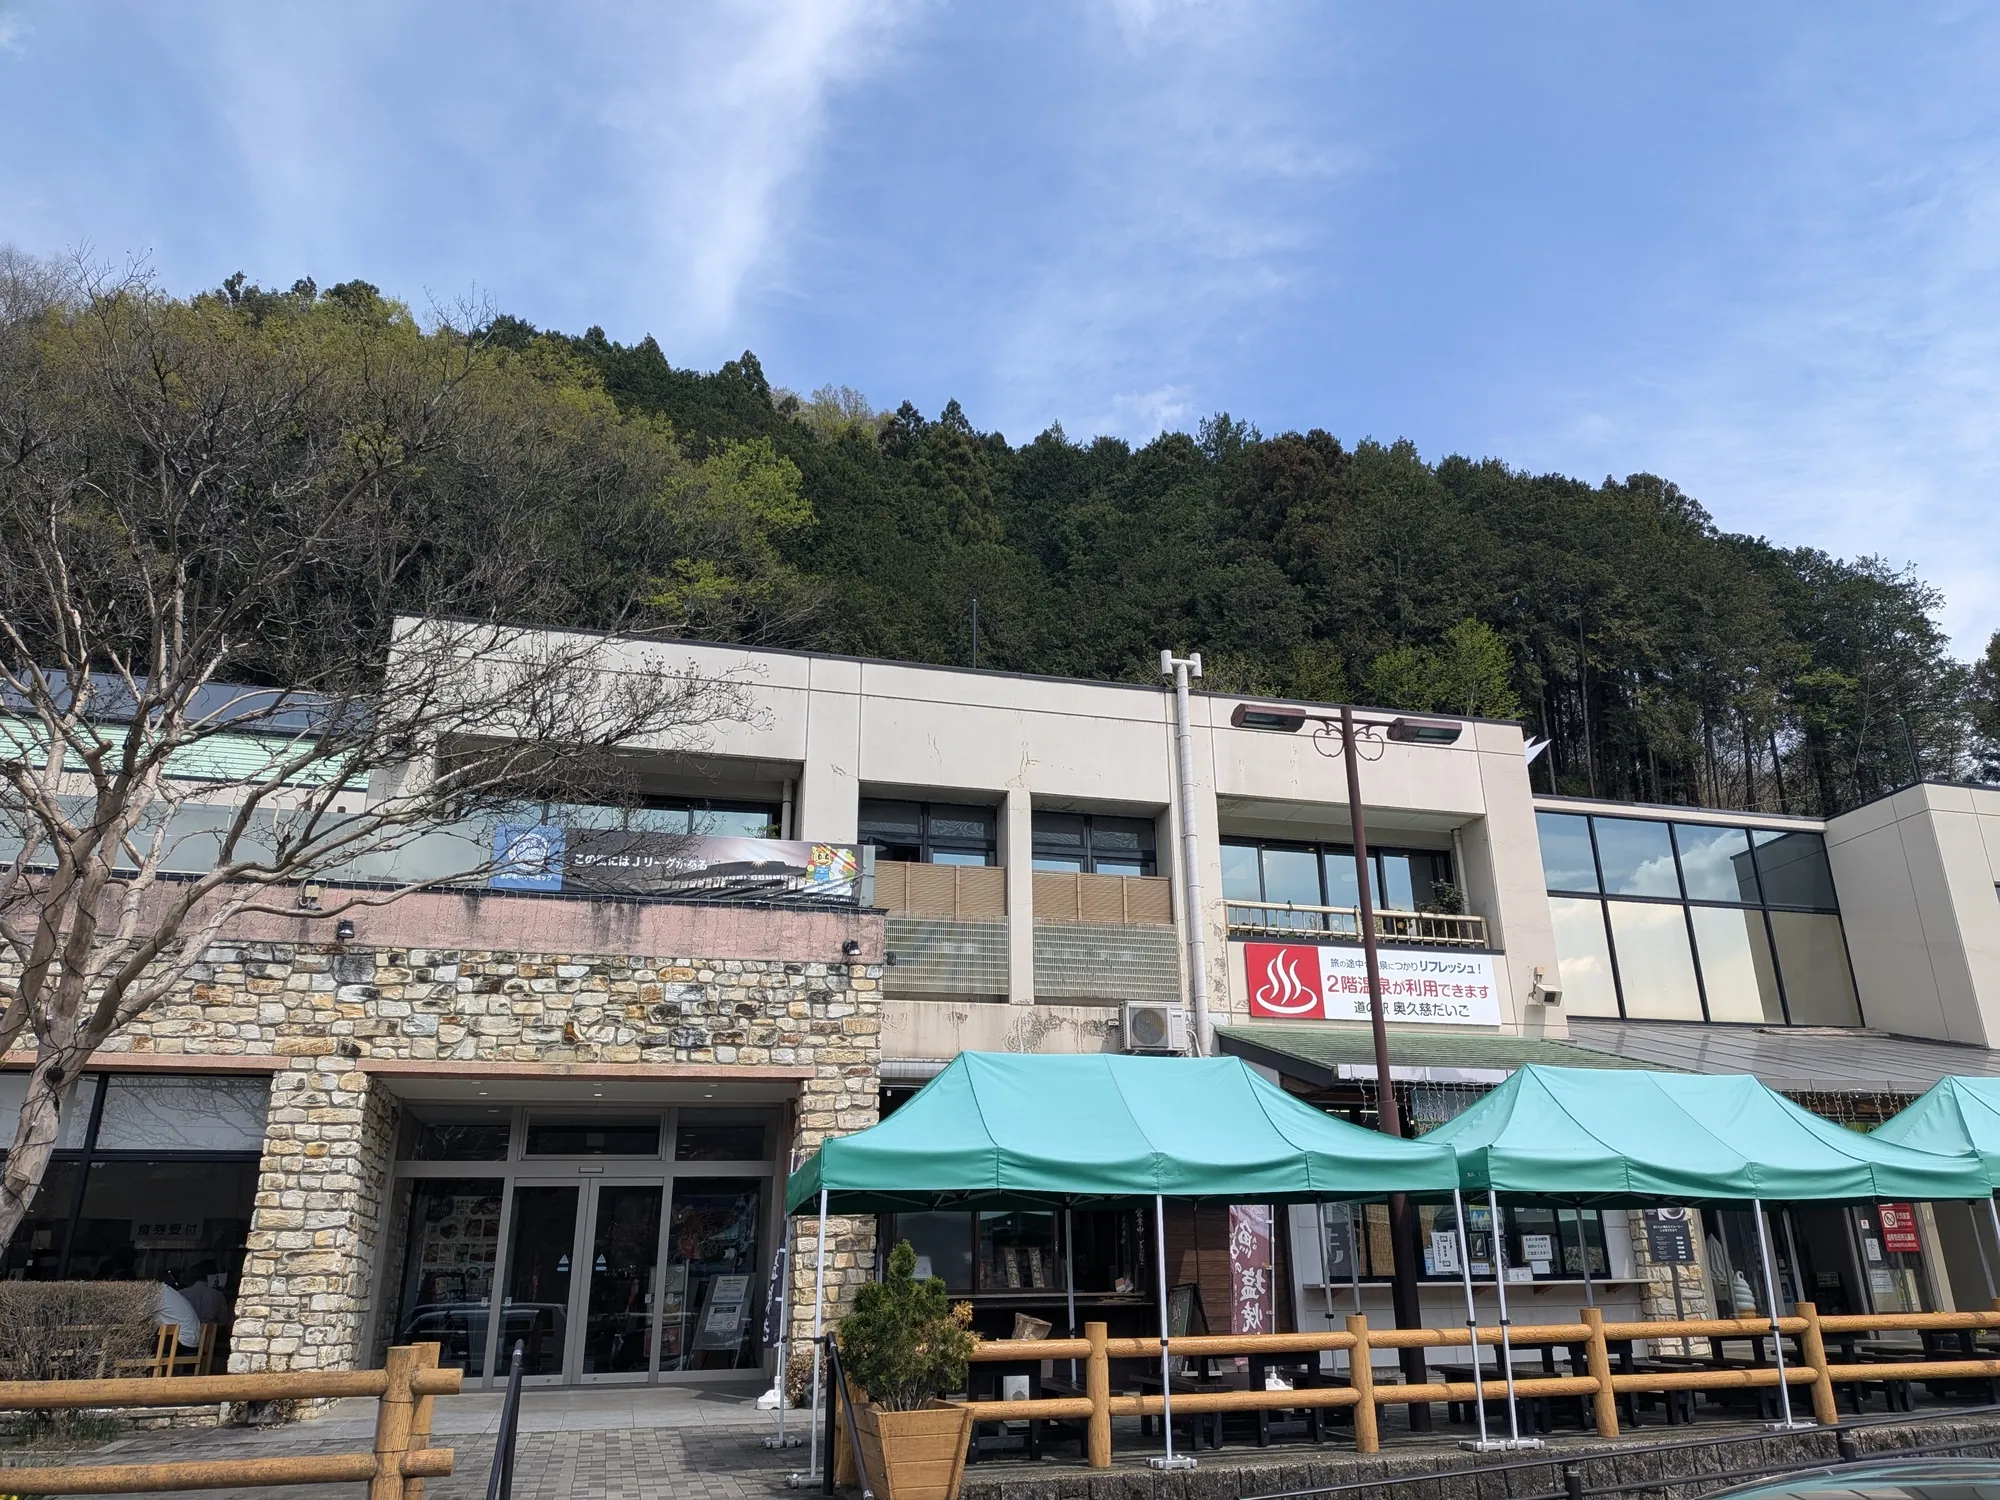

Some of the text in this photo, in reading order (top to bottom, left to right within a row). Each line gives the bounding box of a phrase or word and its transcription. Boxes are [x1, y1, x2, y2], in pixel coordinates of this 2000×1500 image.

[1330, 958, 1481, 975] 旅の途中泉につかりリフレッシュ！
[1326, 974, 1489, 999] 2階温泉が利用できます
[1393, 1001, 1471, 1018] 奥久慈だいご
[136, 1222, 197, 1235] 食券受付
